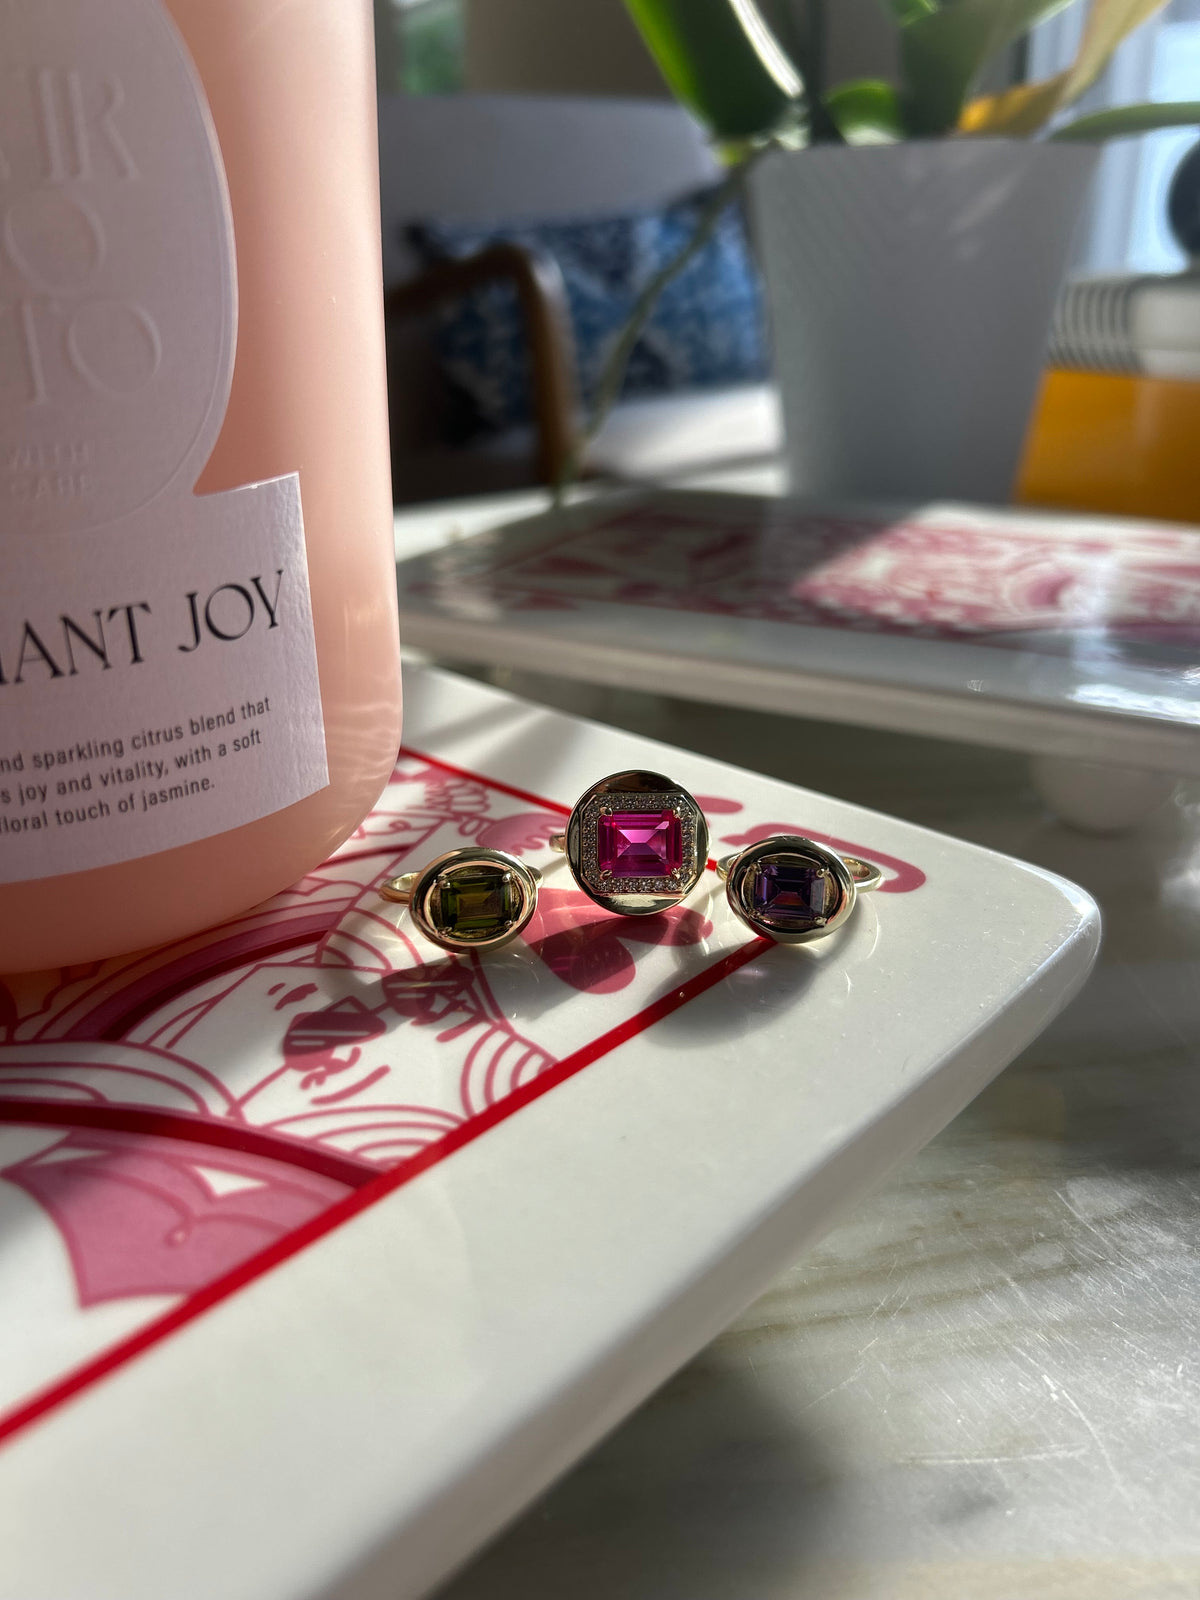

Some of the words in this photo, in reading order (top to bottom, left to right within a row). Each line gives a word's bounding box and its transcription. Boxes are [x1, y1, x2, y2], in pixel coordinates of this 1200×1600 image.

[0, 66, 141, 181] IR
[177, 569, 284, 653] JOY
[18, 781, 48, 806] joy
[56, 772, 93, 796] and
[99, 758, 169, 788] vitality,
[174, 744, 212, 769] with
[218, 743, 227, 757] a
[233, 728, 261, 752] soft
[32, 738, 125, 771] sparkling
[131, 725, 184, 750] citrus
[190, 706, 236, 736] blend
[240, 696, 271, 720] that
[55, 801, 111, 826] touch
[118, 792, 135, 813] of
[142, 776, 215, 812] jasmine.
